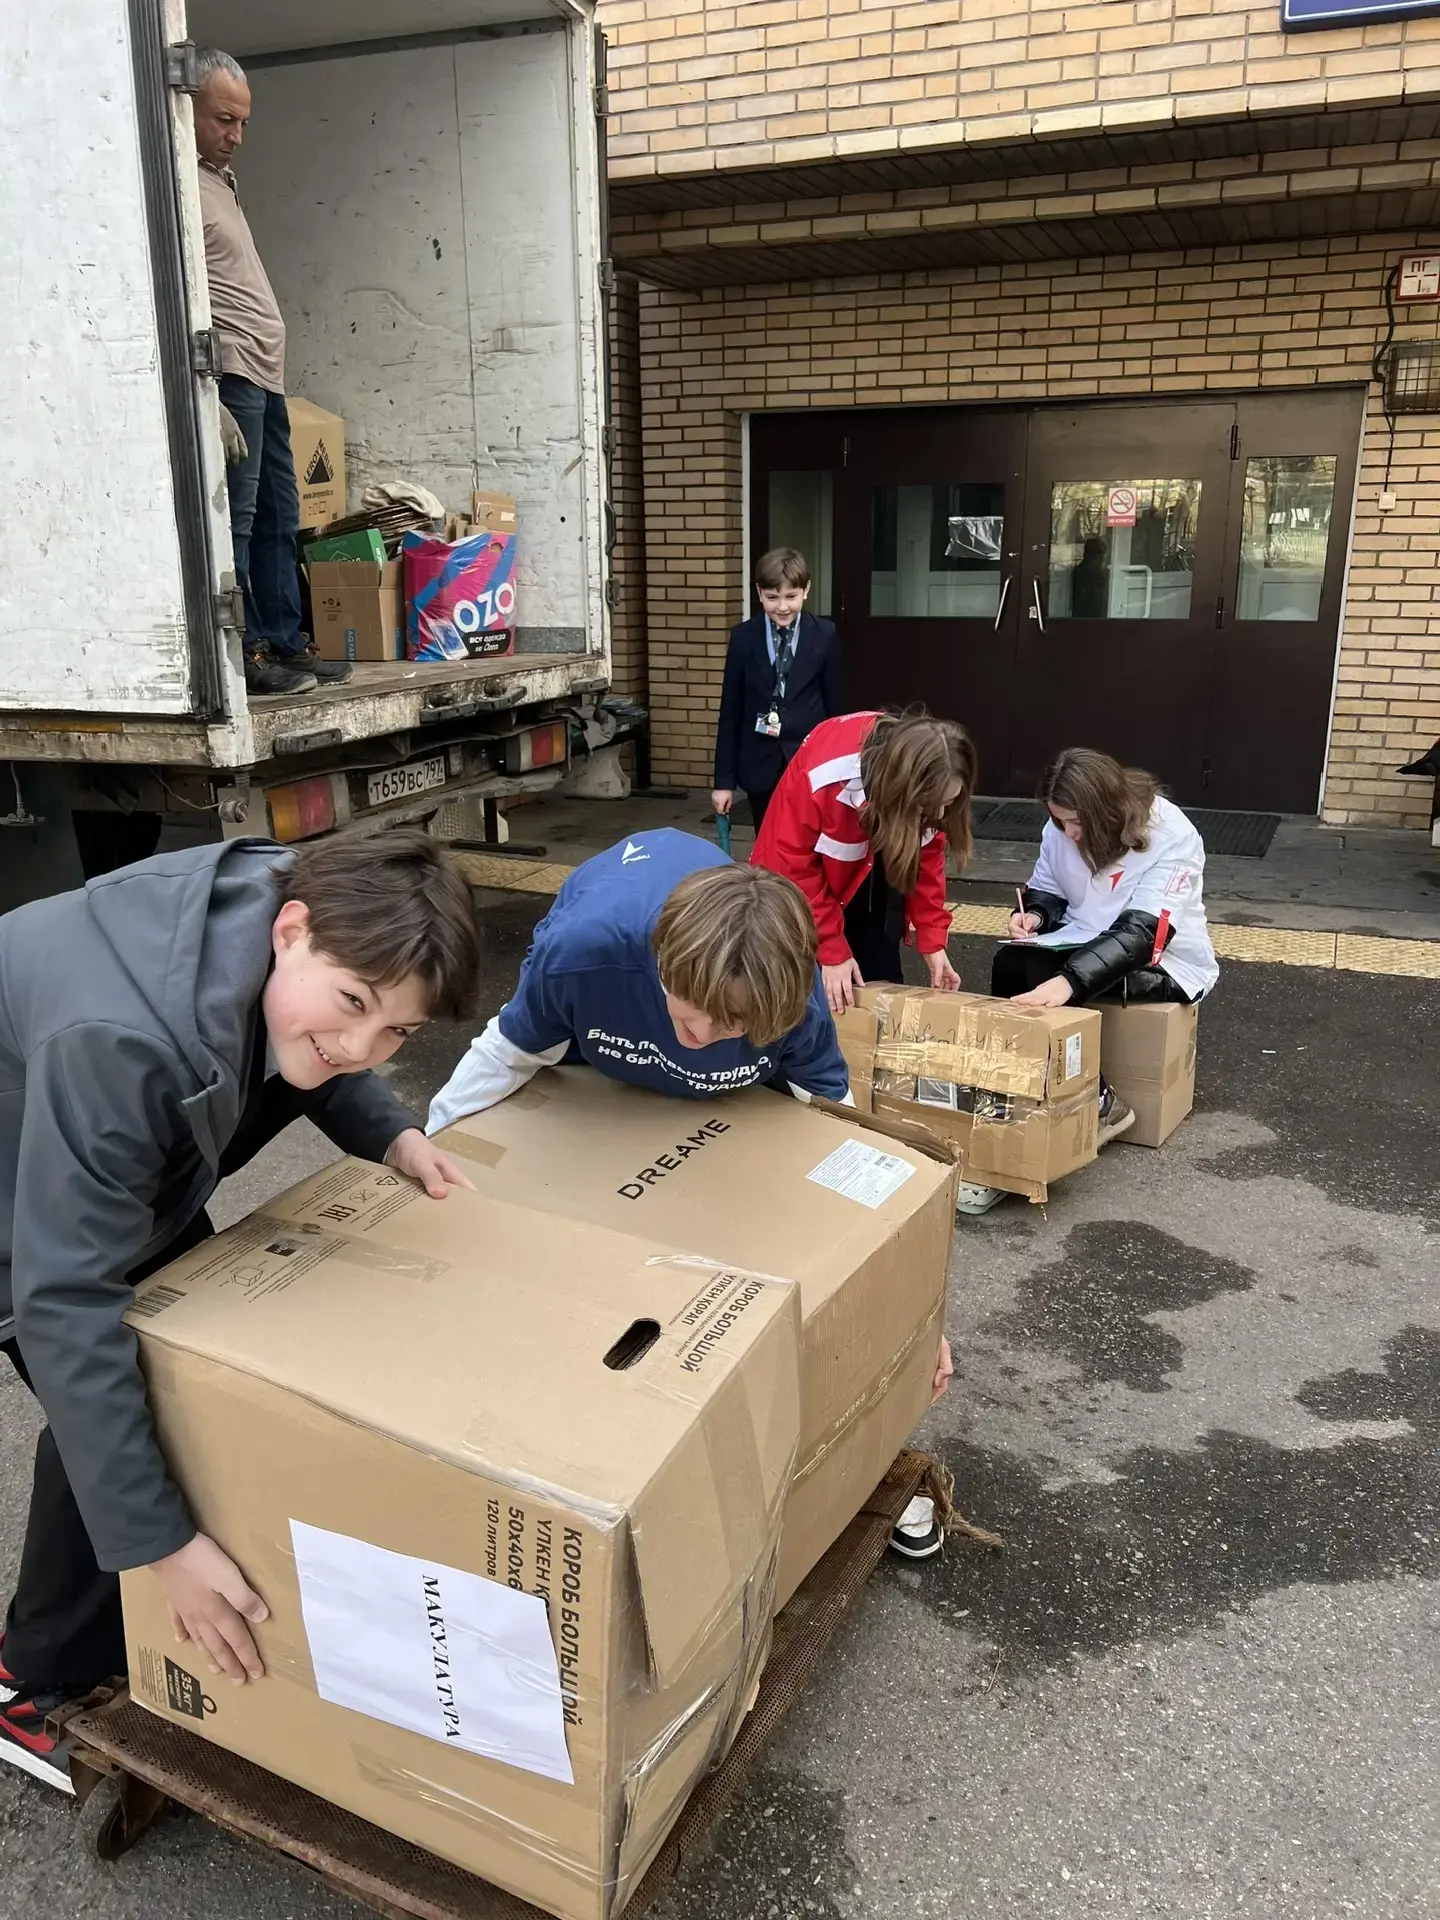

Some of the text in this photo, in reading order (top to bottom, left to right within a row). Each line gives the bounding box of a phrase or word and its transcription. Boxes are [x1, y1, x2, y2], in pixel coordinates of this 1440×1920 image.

[1411, 260, 1430, 272] ПГ
[303, 446, 320, 484] LEROY
[318, 438, 334, 480] MERLIN
[453, 583, 516, 633] OZO
[424, 759, 441, 780] 797
[587, 1029, 635, 1049] Быть
[598, 1046, 622, 1059] не
[617, 1119, 731, 1200] DREAME
[729, 1281, 765, 1312] КОРОБ
[680, 1312, 738, 1373] БОЛЬШОЙ
[486, 1499, 499, 1577] 120 литров
[560, 1526, 582, 1726] КОРОБ БОЛЬШОЙ
[422, 1574, 462, 1738] МАКУЛАТУРА
[181, 1673, 192, 1691] 35
